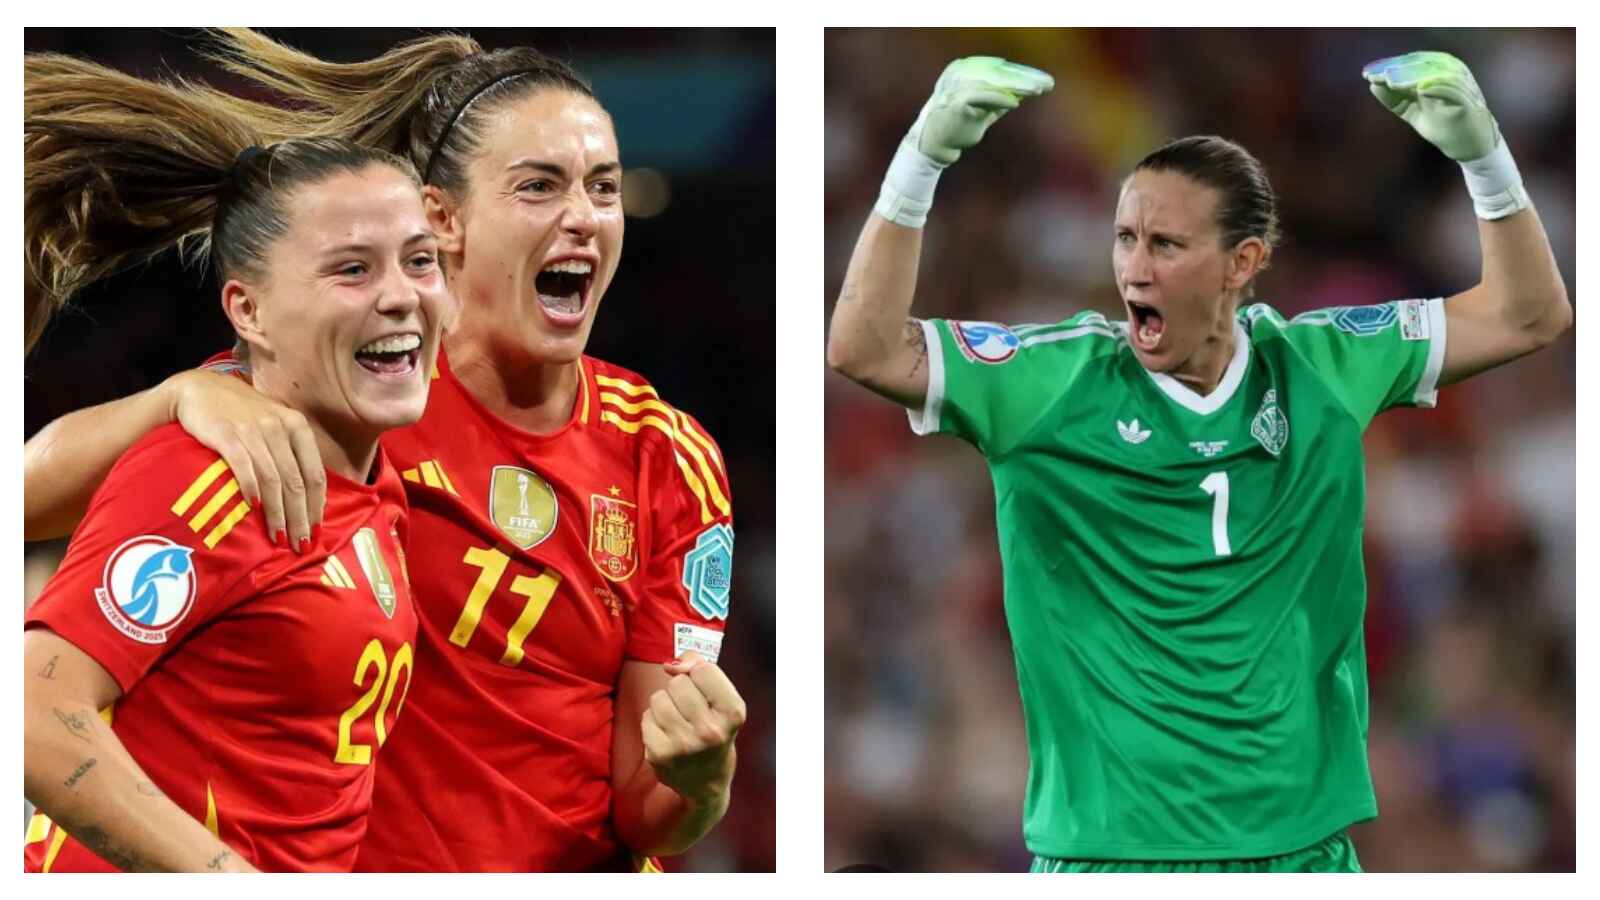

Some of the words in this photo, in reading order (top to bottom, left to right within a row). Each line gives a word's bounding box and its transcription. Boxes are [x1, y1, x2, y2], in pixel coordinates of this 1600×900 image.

[509, 516, 538, 529] FIFA
[1199, 471, 1232, 556] 1
[98, 590, 143, 638] SWITZERLAND
[448, 546, 562, 667] 11
[334, 638, 413, 765] 20
